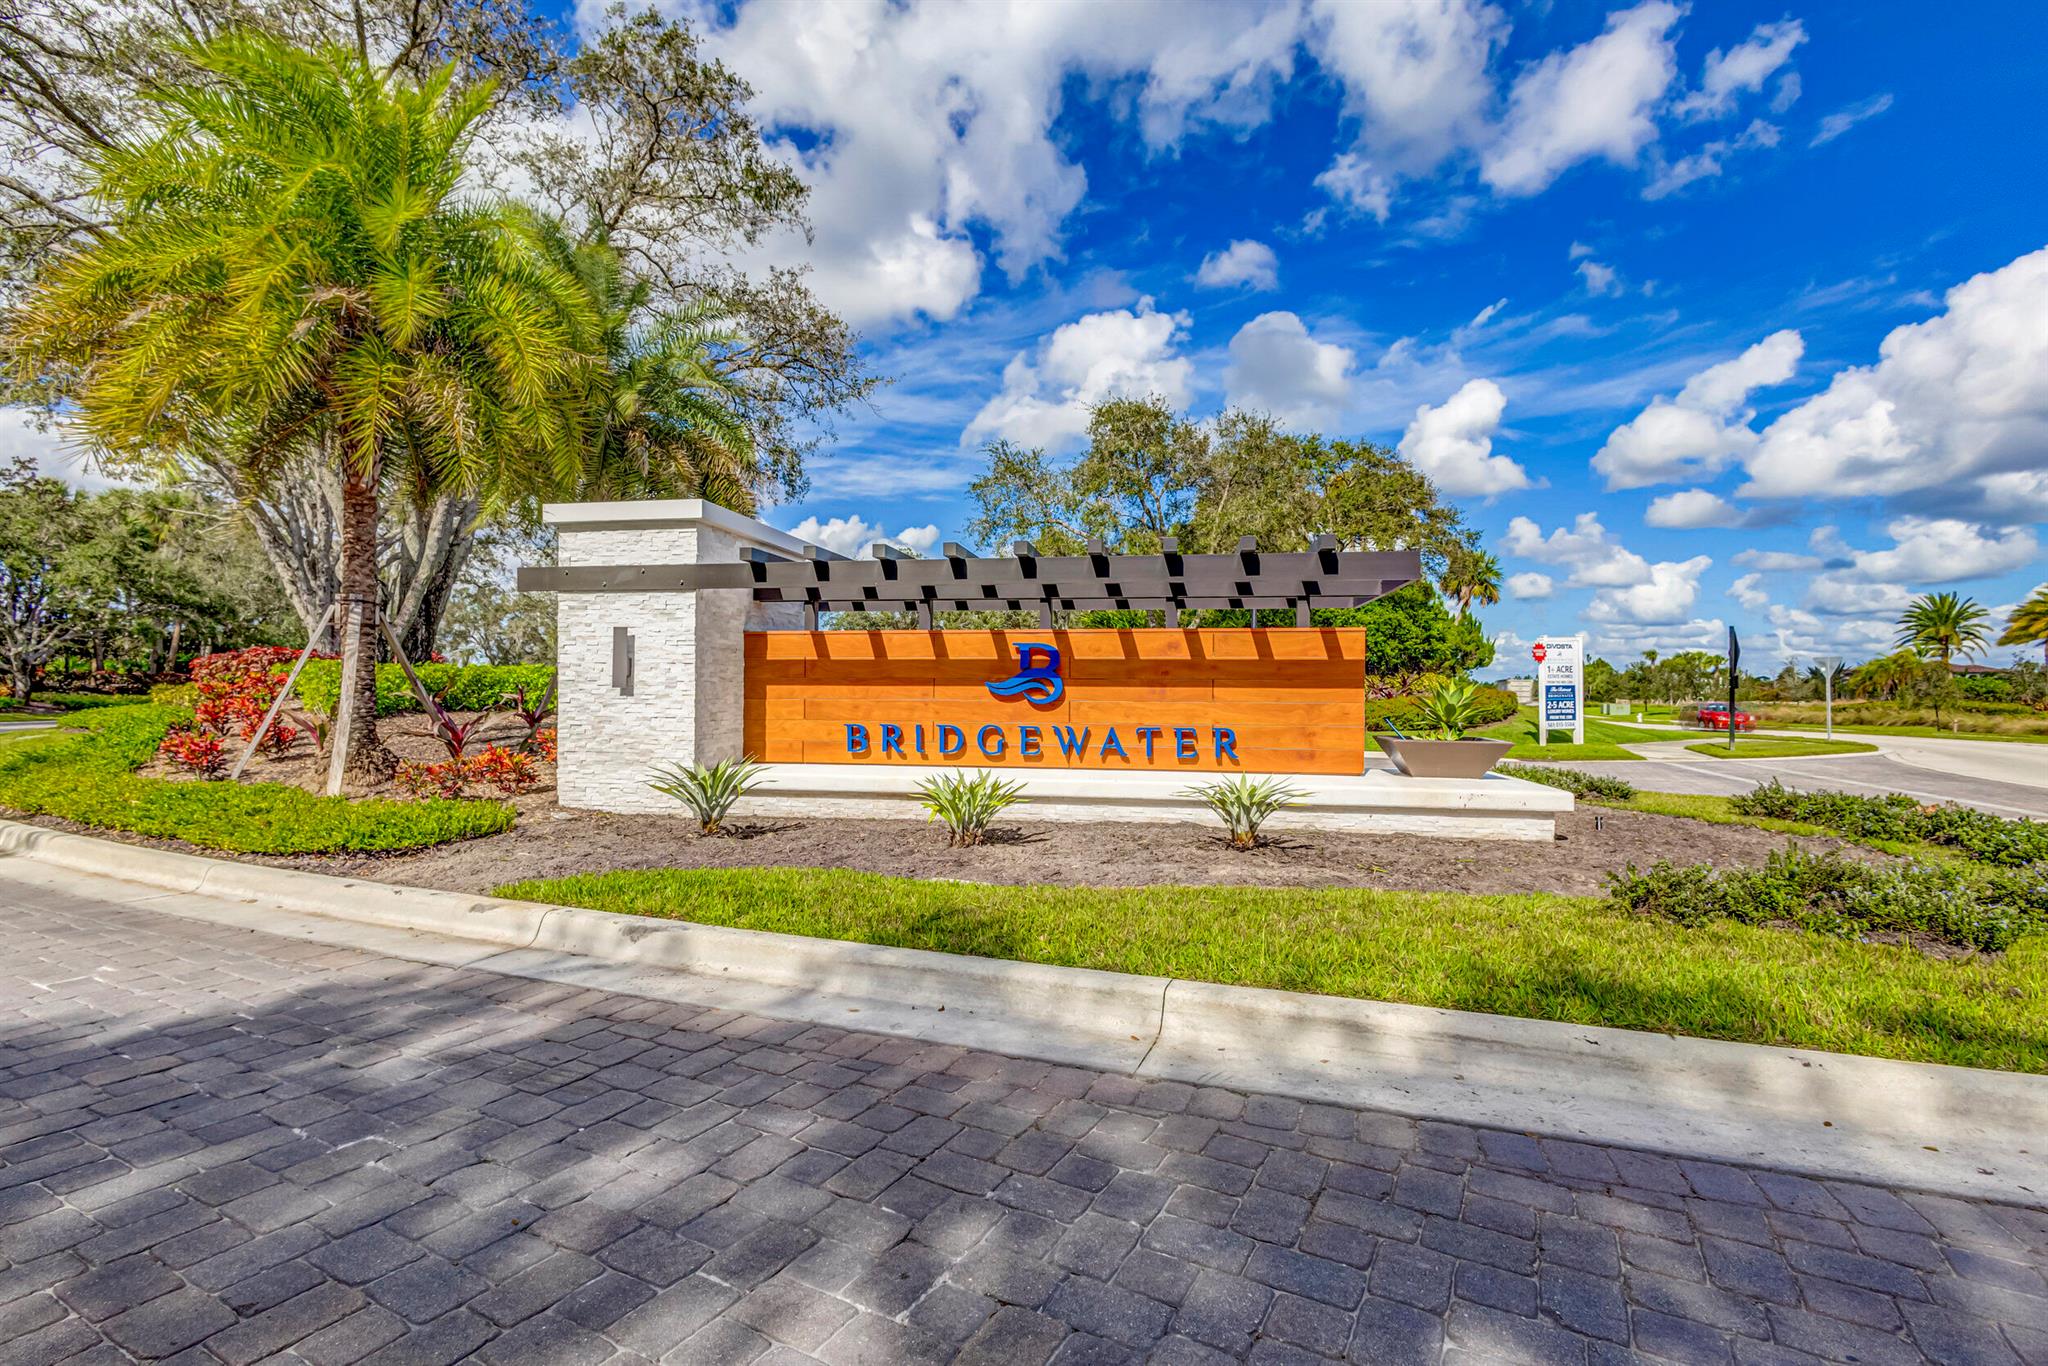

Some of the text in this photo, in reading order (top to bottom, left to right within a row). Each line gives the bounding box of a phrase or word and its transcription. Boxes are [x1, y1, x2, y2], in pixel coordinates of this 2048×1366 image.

[1556, 665, 1574, 674] ACRE
[1547, 701, 1575, 709] 2-5 ACRE
[845, 723, 1240, 760] BRIDGEWATER
